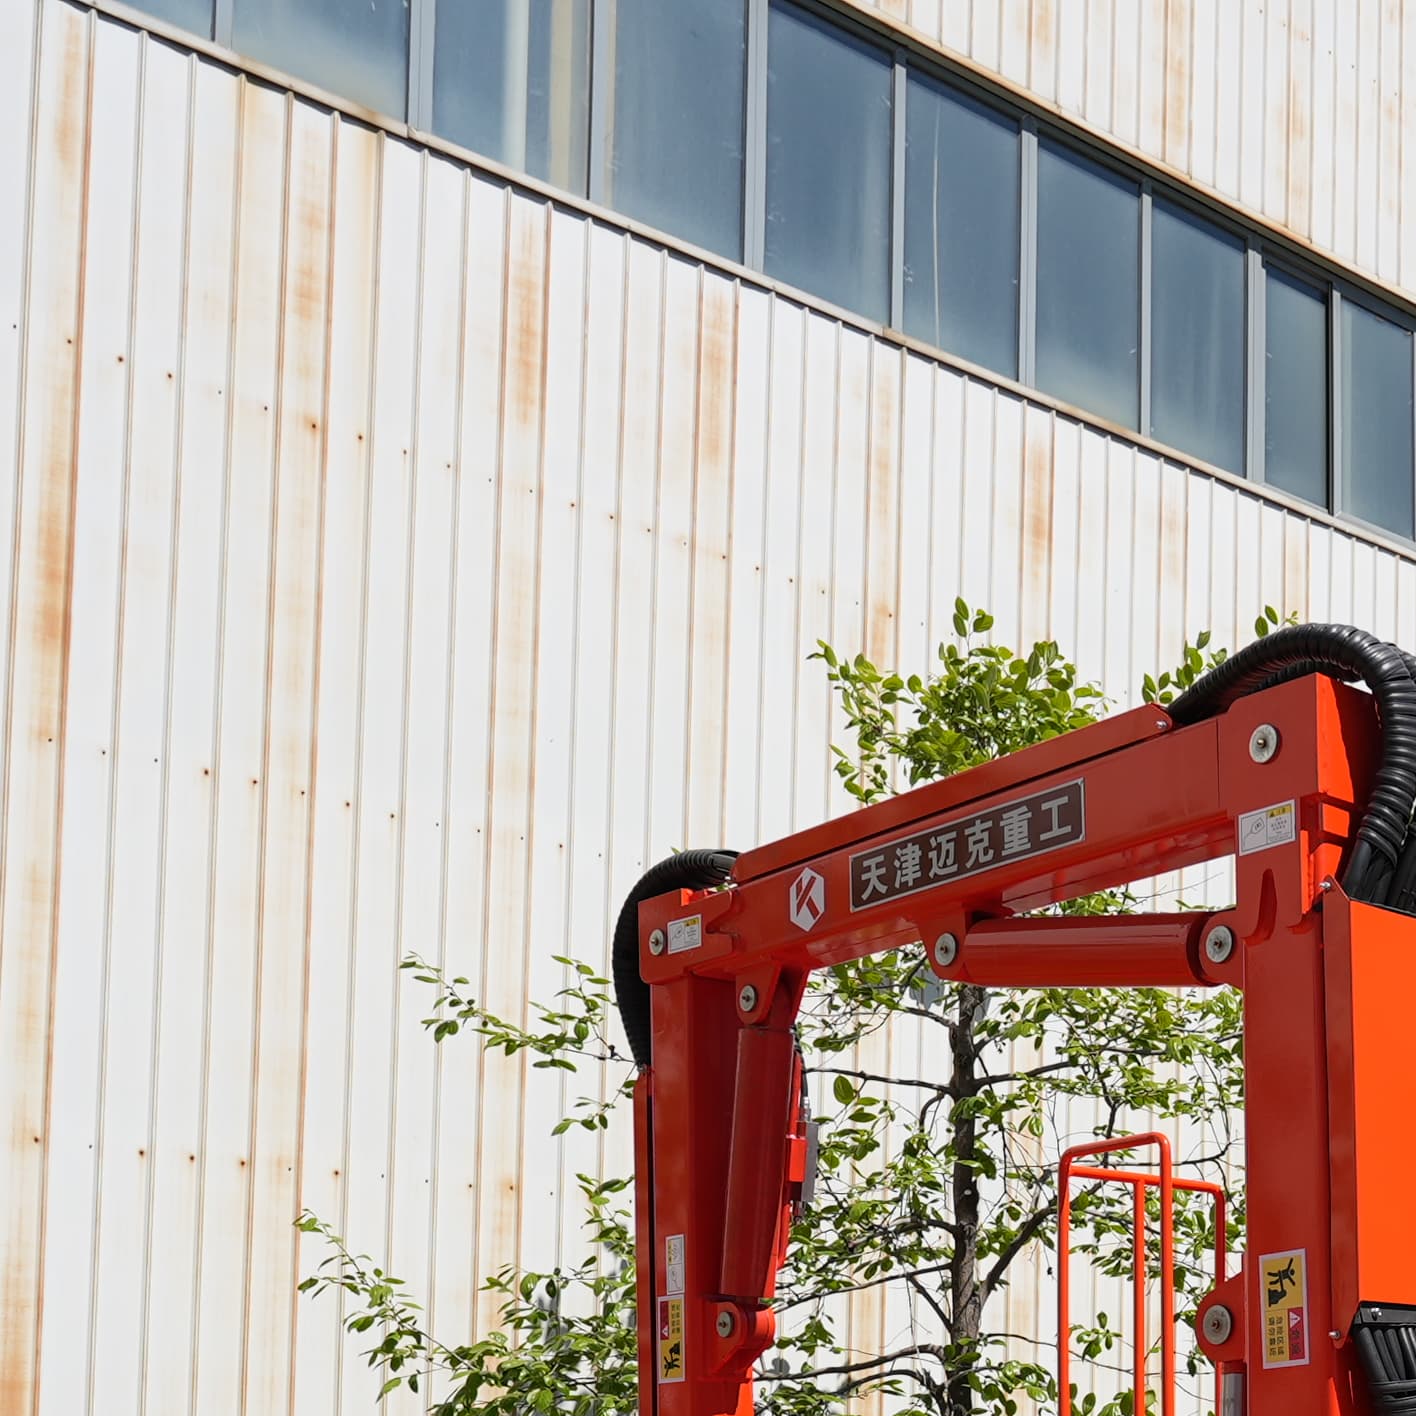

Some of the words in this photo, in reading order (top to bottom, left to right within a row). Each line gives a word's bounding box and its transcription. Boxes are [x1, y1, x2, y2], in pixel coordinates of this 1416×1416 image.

[861, 796, 1073, 900] 天津迈克重工
